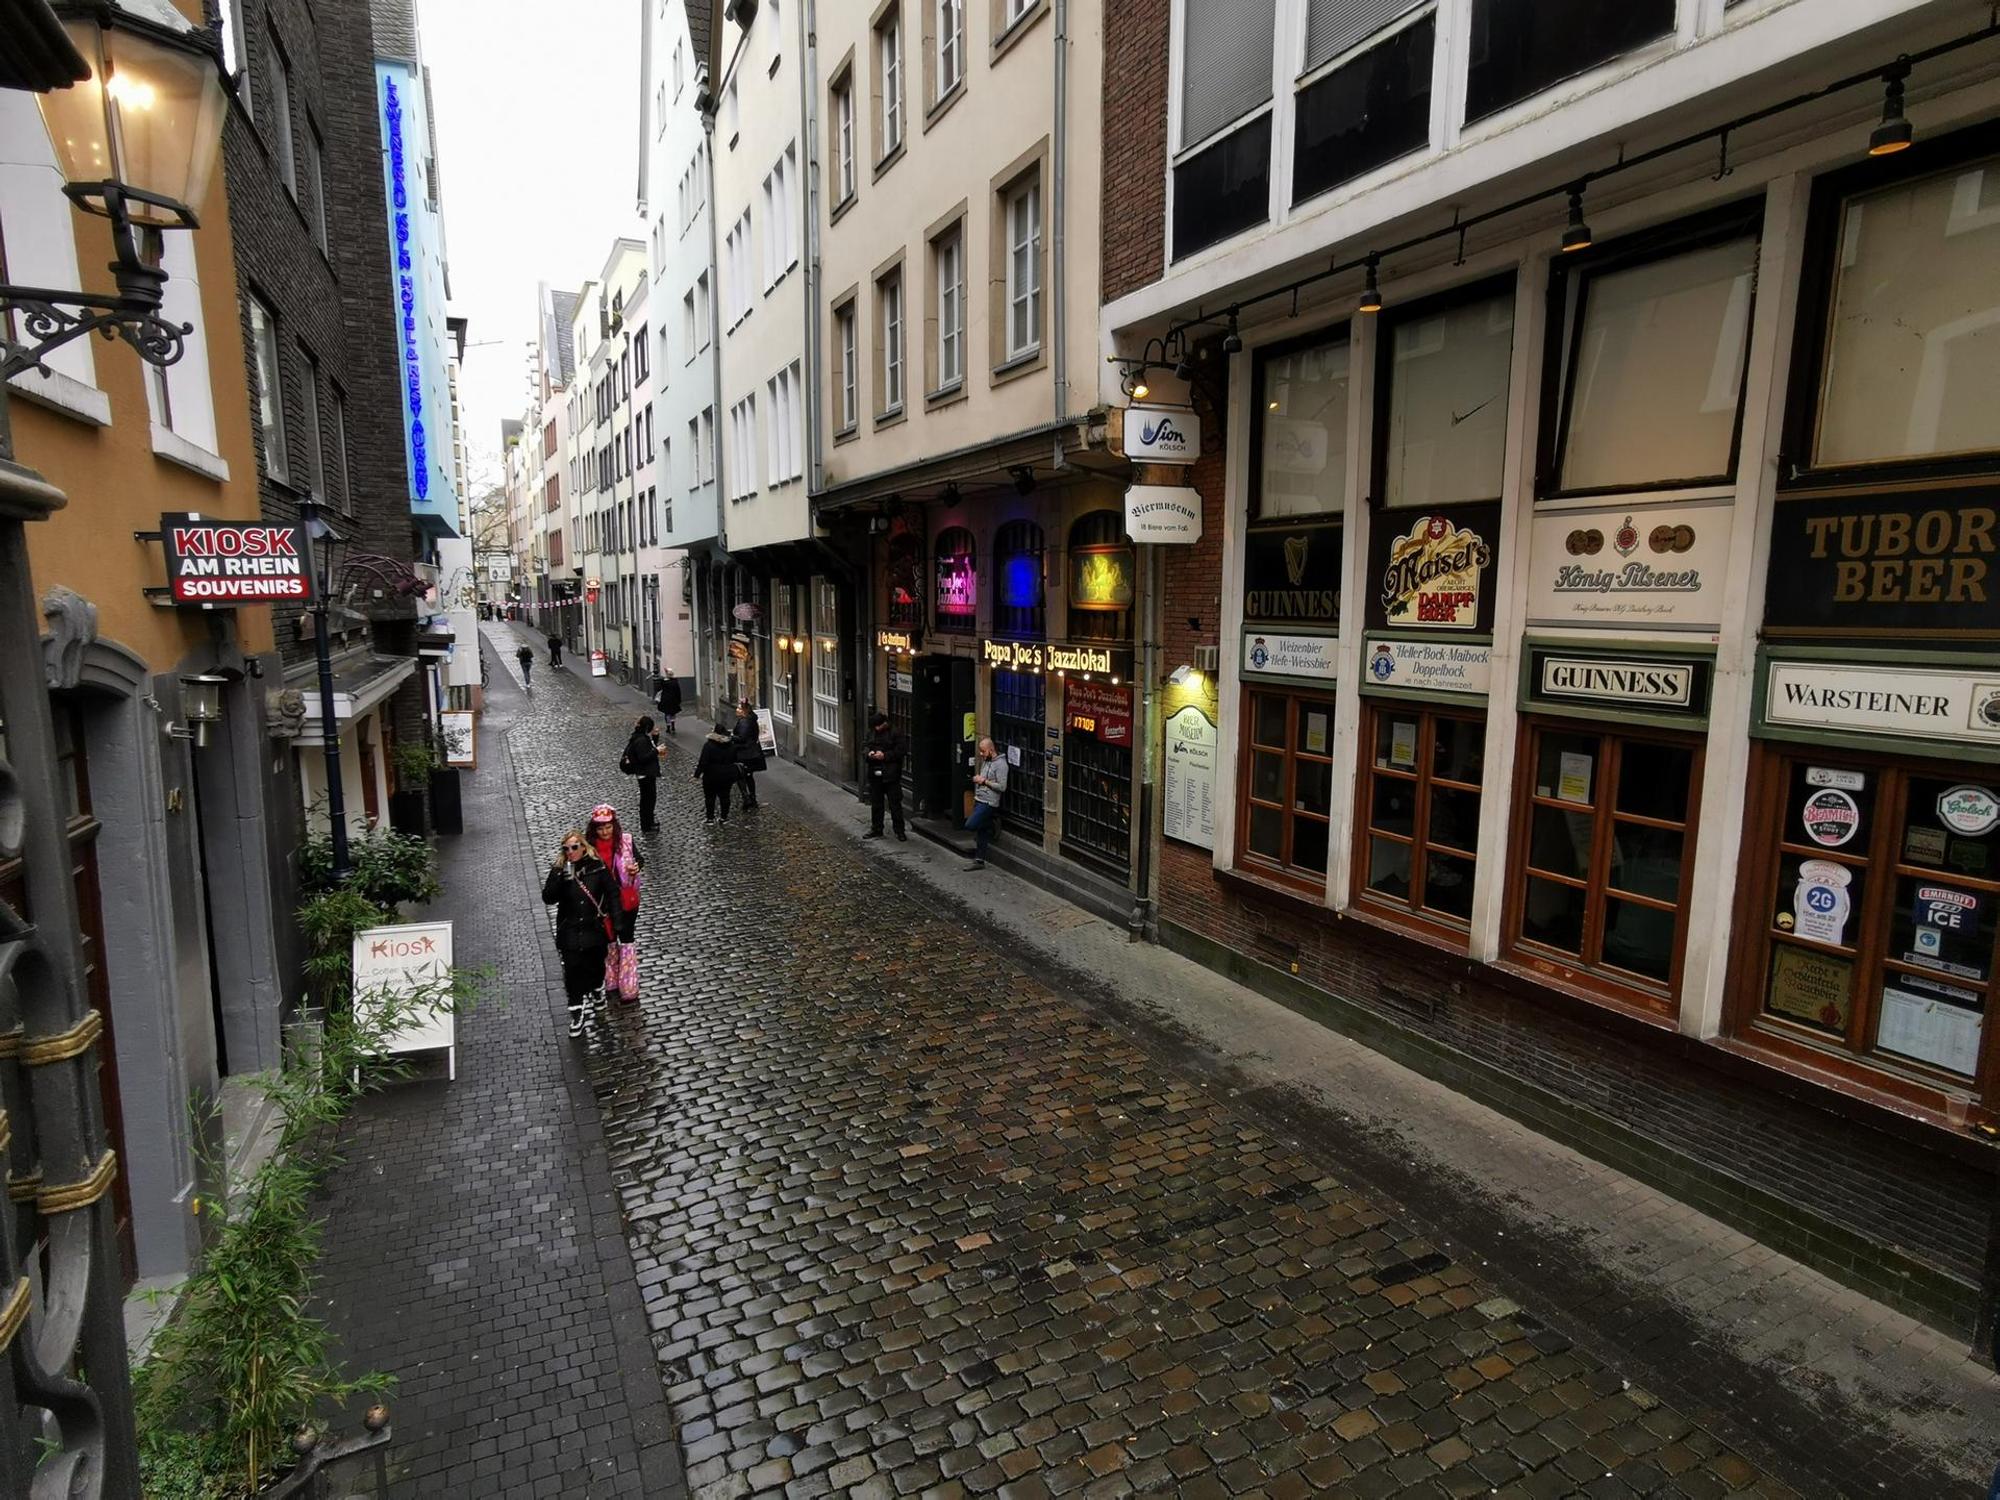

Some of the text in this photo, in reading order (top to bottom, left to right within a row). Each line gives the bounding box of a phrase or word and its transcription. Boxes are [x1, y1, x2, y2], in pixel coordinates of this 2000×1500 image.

[400, 274, 416, 344] HOTEL
[407, 364, 428, 500] RESTAURANT
[1139, 418, 1186, 446] Sion
[1159, 444, 1186, 452] KÖLSCH
[1131, 502, 1196, 520] Biermuseum
[173, 527, 298, 557] KIOSK
[180, 557, 300, 576] AM RHEIN
[1383, 541, 1490, 601] Maisel's
[183, 579, 304, 597] SOUVENIRS
[1833, 558, 1987, 603] BEER
[1418, 591, 1475, 608] DAMPF
[984, 639, 1011, 665] Papa
[1047, 645, 1111, 673] Jazzlokal
[1280, 641, 1324, 655] Weizenbier
[1396, 645, 1423, 659] Heller
[1270, 654, 1332, 669] Hefe-Weissbier
[1412, 661, 1466, 678] Doppelbock
[1413, 678, 1432, 687] nach
[1433, 678, 1473, 690] Jahreszeit
[1552, 666, 1679, 696] GUINNESS
[1784, 683, 1951, 717] WARSTEINER
[1805, 805, 1857, 825] BEAMISH
[1947, 799, 1993, 816] Grolsch
[1810, 891, 1833, 908] 2G
[1922, 889, 1972, 907] SMIRNOFF
[1927, 909, 1962, 928] ICE
